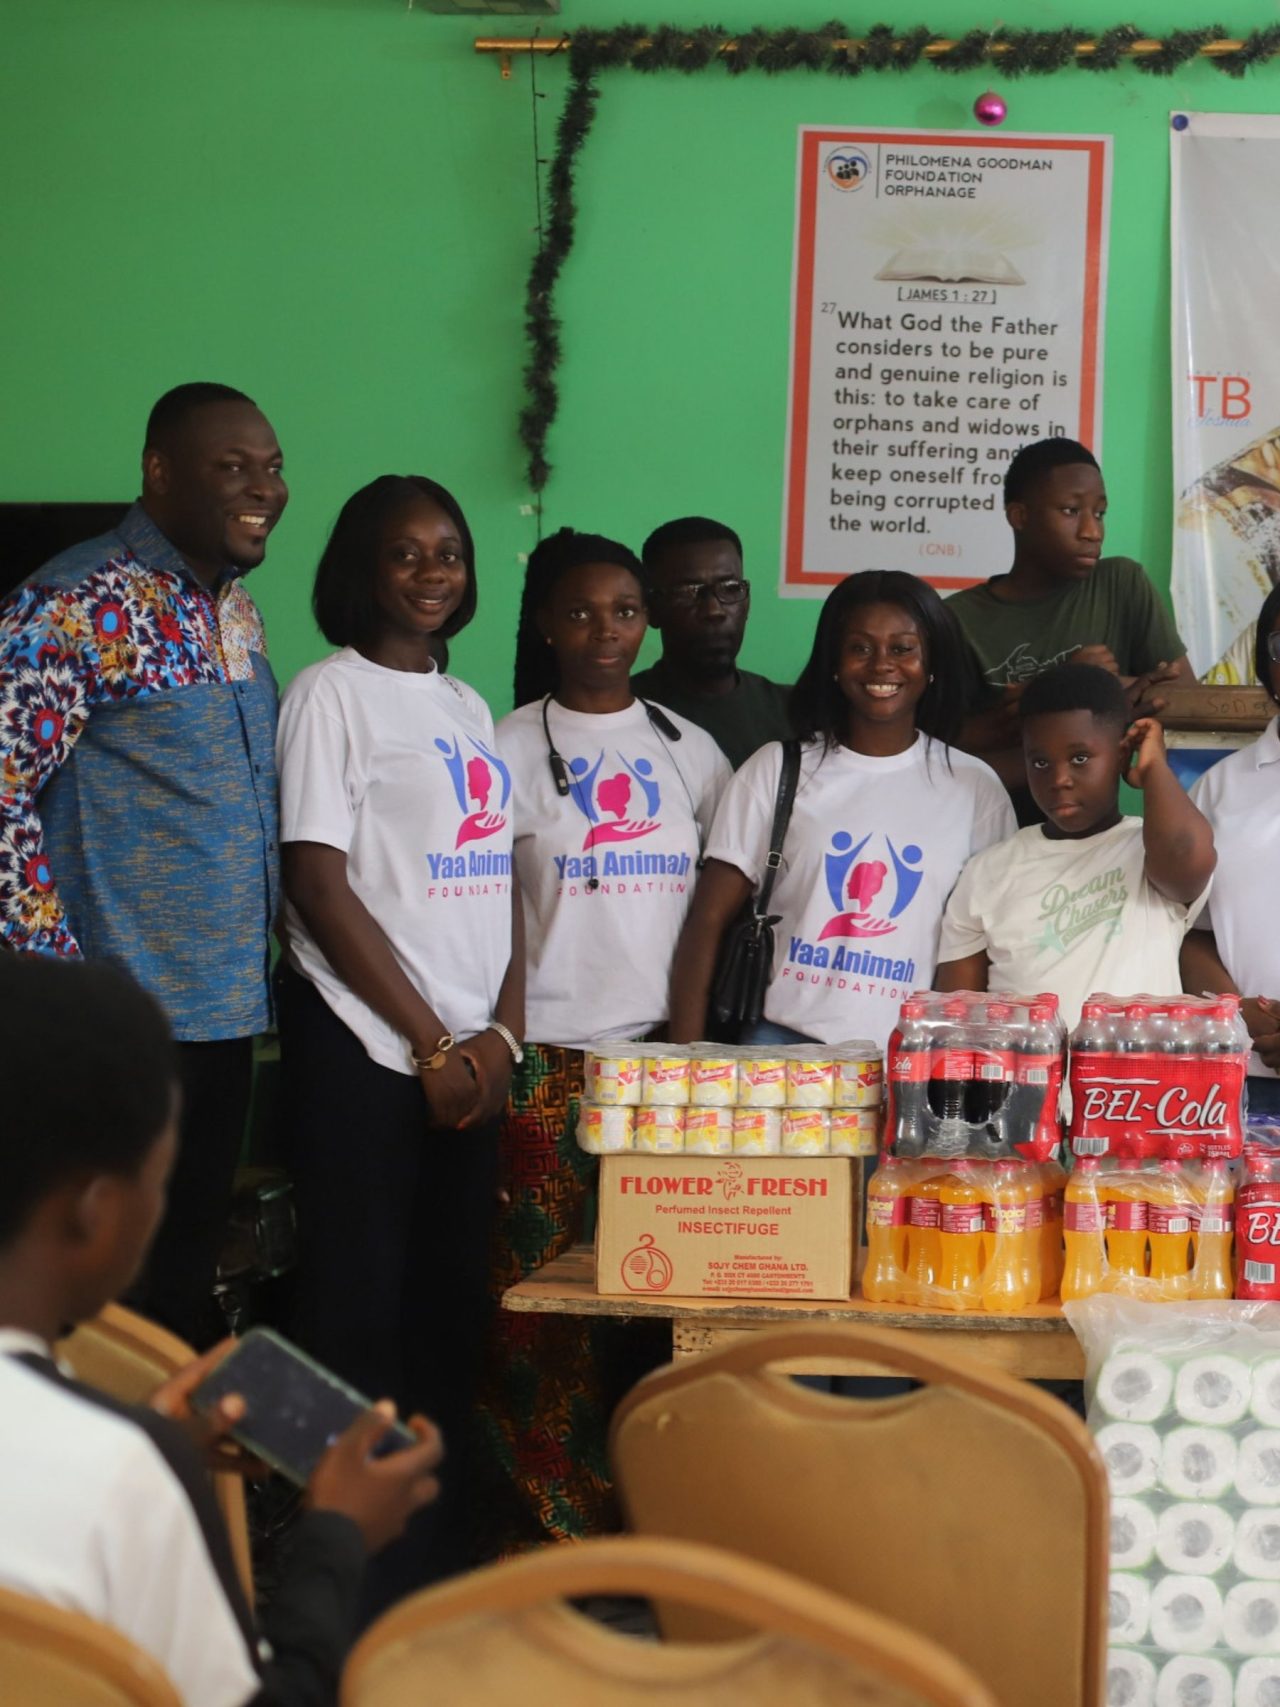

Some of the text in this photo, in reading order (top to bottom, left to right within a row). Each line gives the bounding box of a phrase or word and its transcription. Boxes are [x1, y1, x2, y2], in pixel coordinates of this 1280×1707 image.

[886, 154, 1053, 171] PHILOMENA GOODMAN
[885, 170, 982, 184] FOUNDATION
[885, 185, 976, 199] ORPHANAGE
[821, 302, 836, 314] 27
[839, 310, 1058, 336] What God the Father
[836, 339, 1049, 370] considers to be pure
[835, 363, 1068, 389] and genuine religion is
[834, 389, 1041, 411] this: to take care of
[1187, 376, 1252, 420] TB
[833, 414, 1066, 437] orphans and widows in
[832, 439, 879, 456] their
[887, 441, 978, 463] suffering
[831, 463, 1007, 486] keep oneself fro
[830, 489, 995, 514] being corrupted
[829, 515, 931, 534] the world.
[426, 850, 512, 880] Yaa Anim
[553, 850, 692, 879] Yaa Animah
[1038, 866, 1125, 920] Dream
[1054, 885, 1128, 936] Chasers
[788, 936, 916, 983] Yaa Animah
[781, 967, 910, 1001] FOUNDATION
[620, 1176, 828, 1197] FLOWER FRESH
[655, 1205, 792, 1217] Perfumed Insect Repellent
[678, 1221, 779, 1236] INSECTIFUGE
[708, 1262, 730, 1270] SOJY
[732, 1262, 756, 1271] CHEM
[759, 1263, 788, 1271] GHANA
